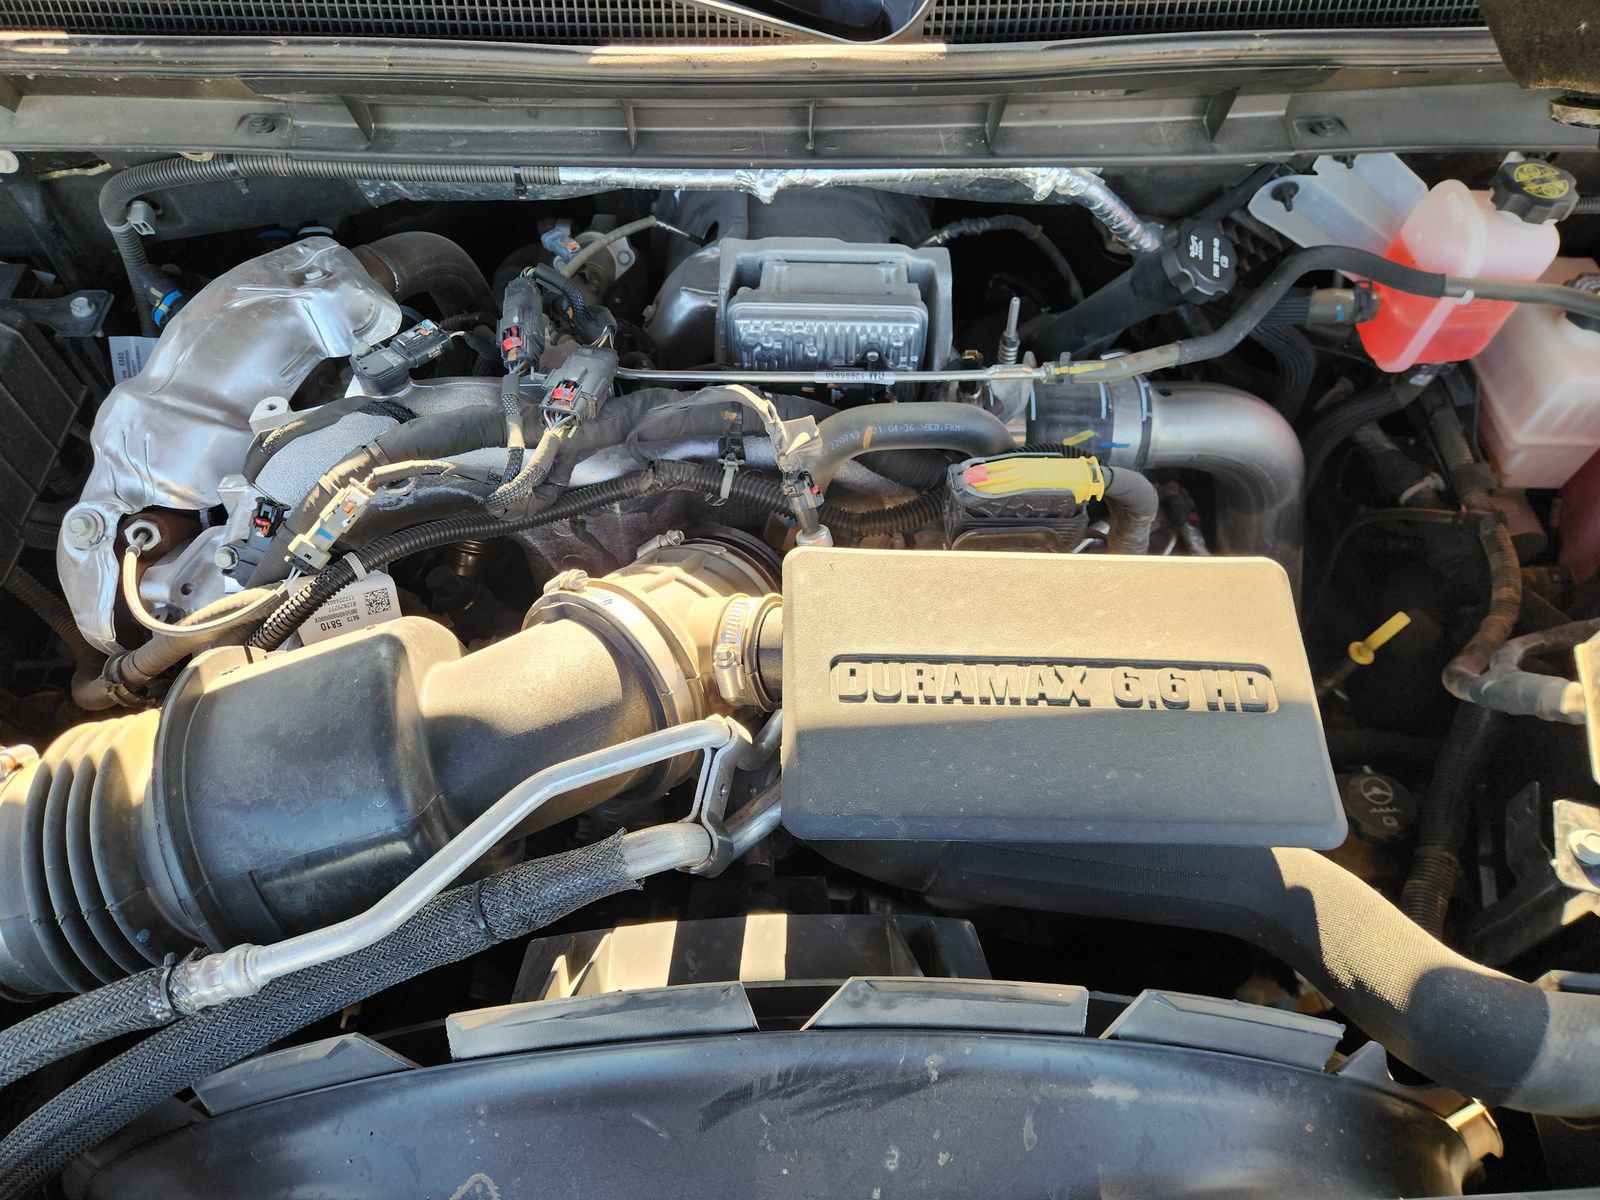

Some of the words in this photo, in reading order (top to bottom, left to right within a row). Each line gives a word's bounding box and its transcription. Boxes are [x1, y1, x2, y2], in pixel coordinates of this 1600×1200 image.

[320, 619, 342, 631] 5810
[833, 660, 1092, 708] DURAMAX
[1111, 667, 1191, 712] 6.6
[1200, 669, 1273, 713] HD
